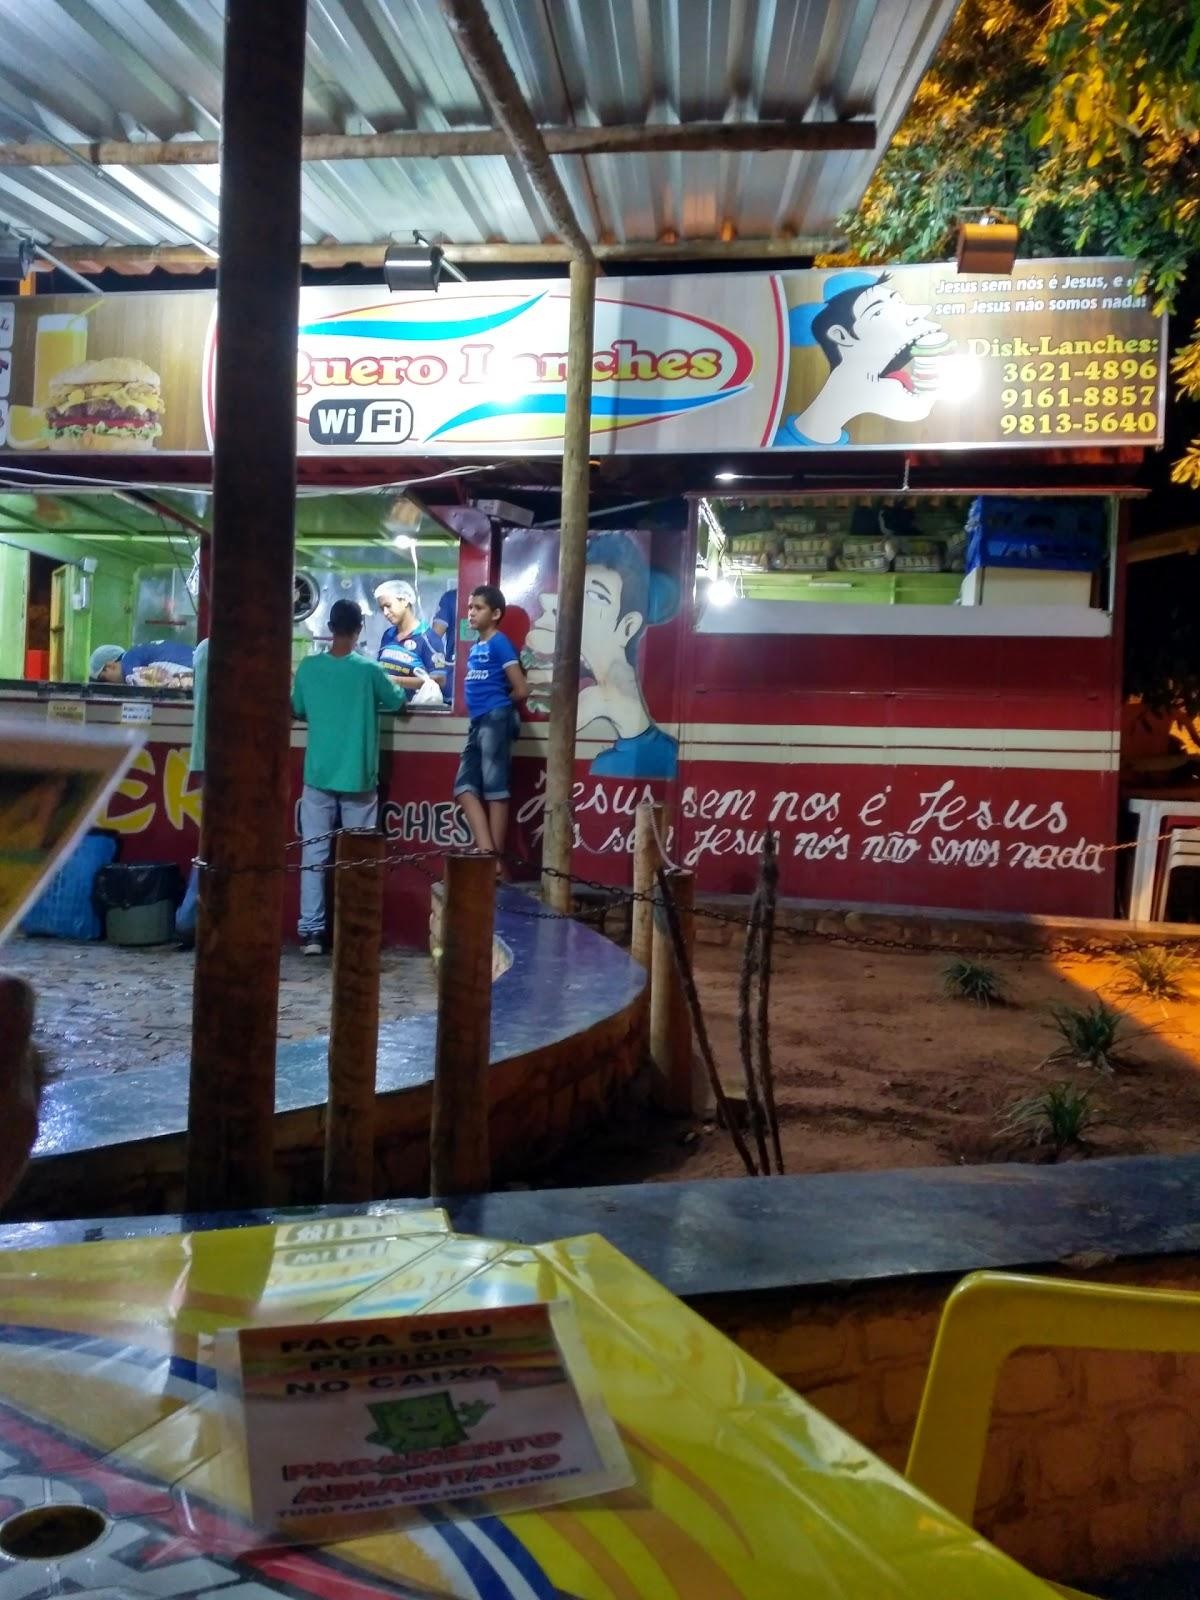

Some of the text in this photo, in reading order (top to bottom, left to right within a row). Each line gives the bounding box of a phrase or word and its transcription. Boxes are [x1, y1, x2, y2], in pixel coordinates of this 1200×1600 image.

[936, 279, 979, 295] Jesus
[981, 278, 1012, 293] sem
[1016, 274, 1044, 290] nós
[1048, 274, 1057, 289] é
[1062, 274, 1107, 290] Jesus,
[1113, 275, 1123, 288] e
[935, 303, 966, 316] sem
[969, 300, 1010, 315] Jesus
[1015, 297, 1044, 313] não
[1049, 297, 1097, 311] somos
[967, 334, 1159, 358] Disk-Lanches:
[1002, 359, 1158, 383] 3621-4896
[1001, 385, 1157, 409] 9161-8857
[1000, 412, 1157, 435] 9813-5640
[682, 785, 757, 821] sem
[768, 788, 841, 823] nos
[858, 785, 892, 826] é
[907, 779, 1068, 834] Jesus
[794, 827, 850, 860] nós
[861, 831, 921, 863] não
[1007, 837, 1106, 873] nada
[280, 1324, 492, 1354] FAÇA SEU
[310, 1347, 473, 1372] PEDIDO
[285, 1364, 505, 1396] NO CAIXA
[341, 1498, 395, 1512] PARA
